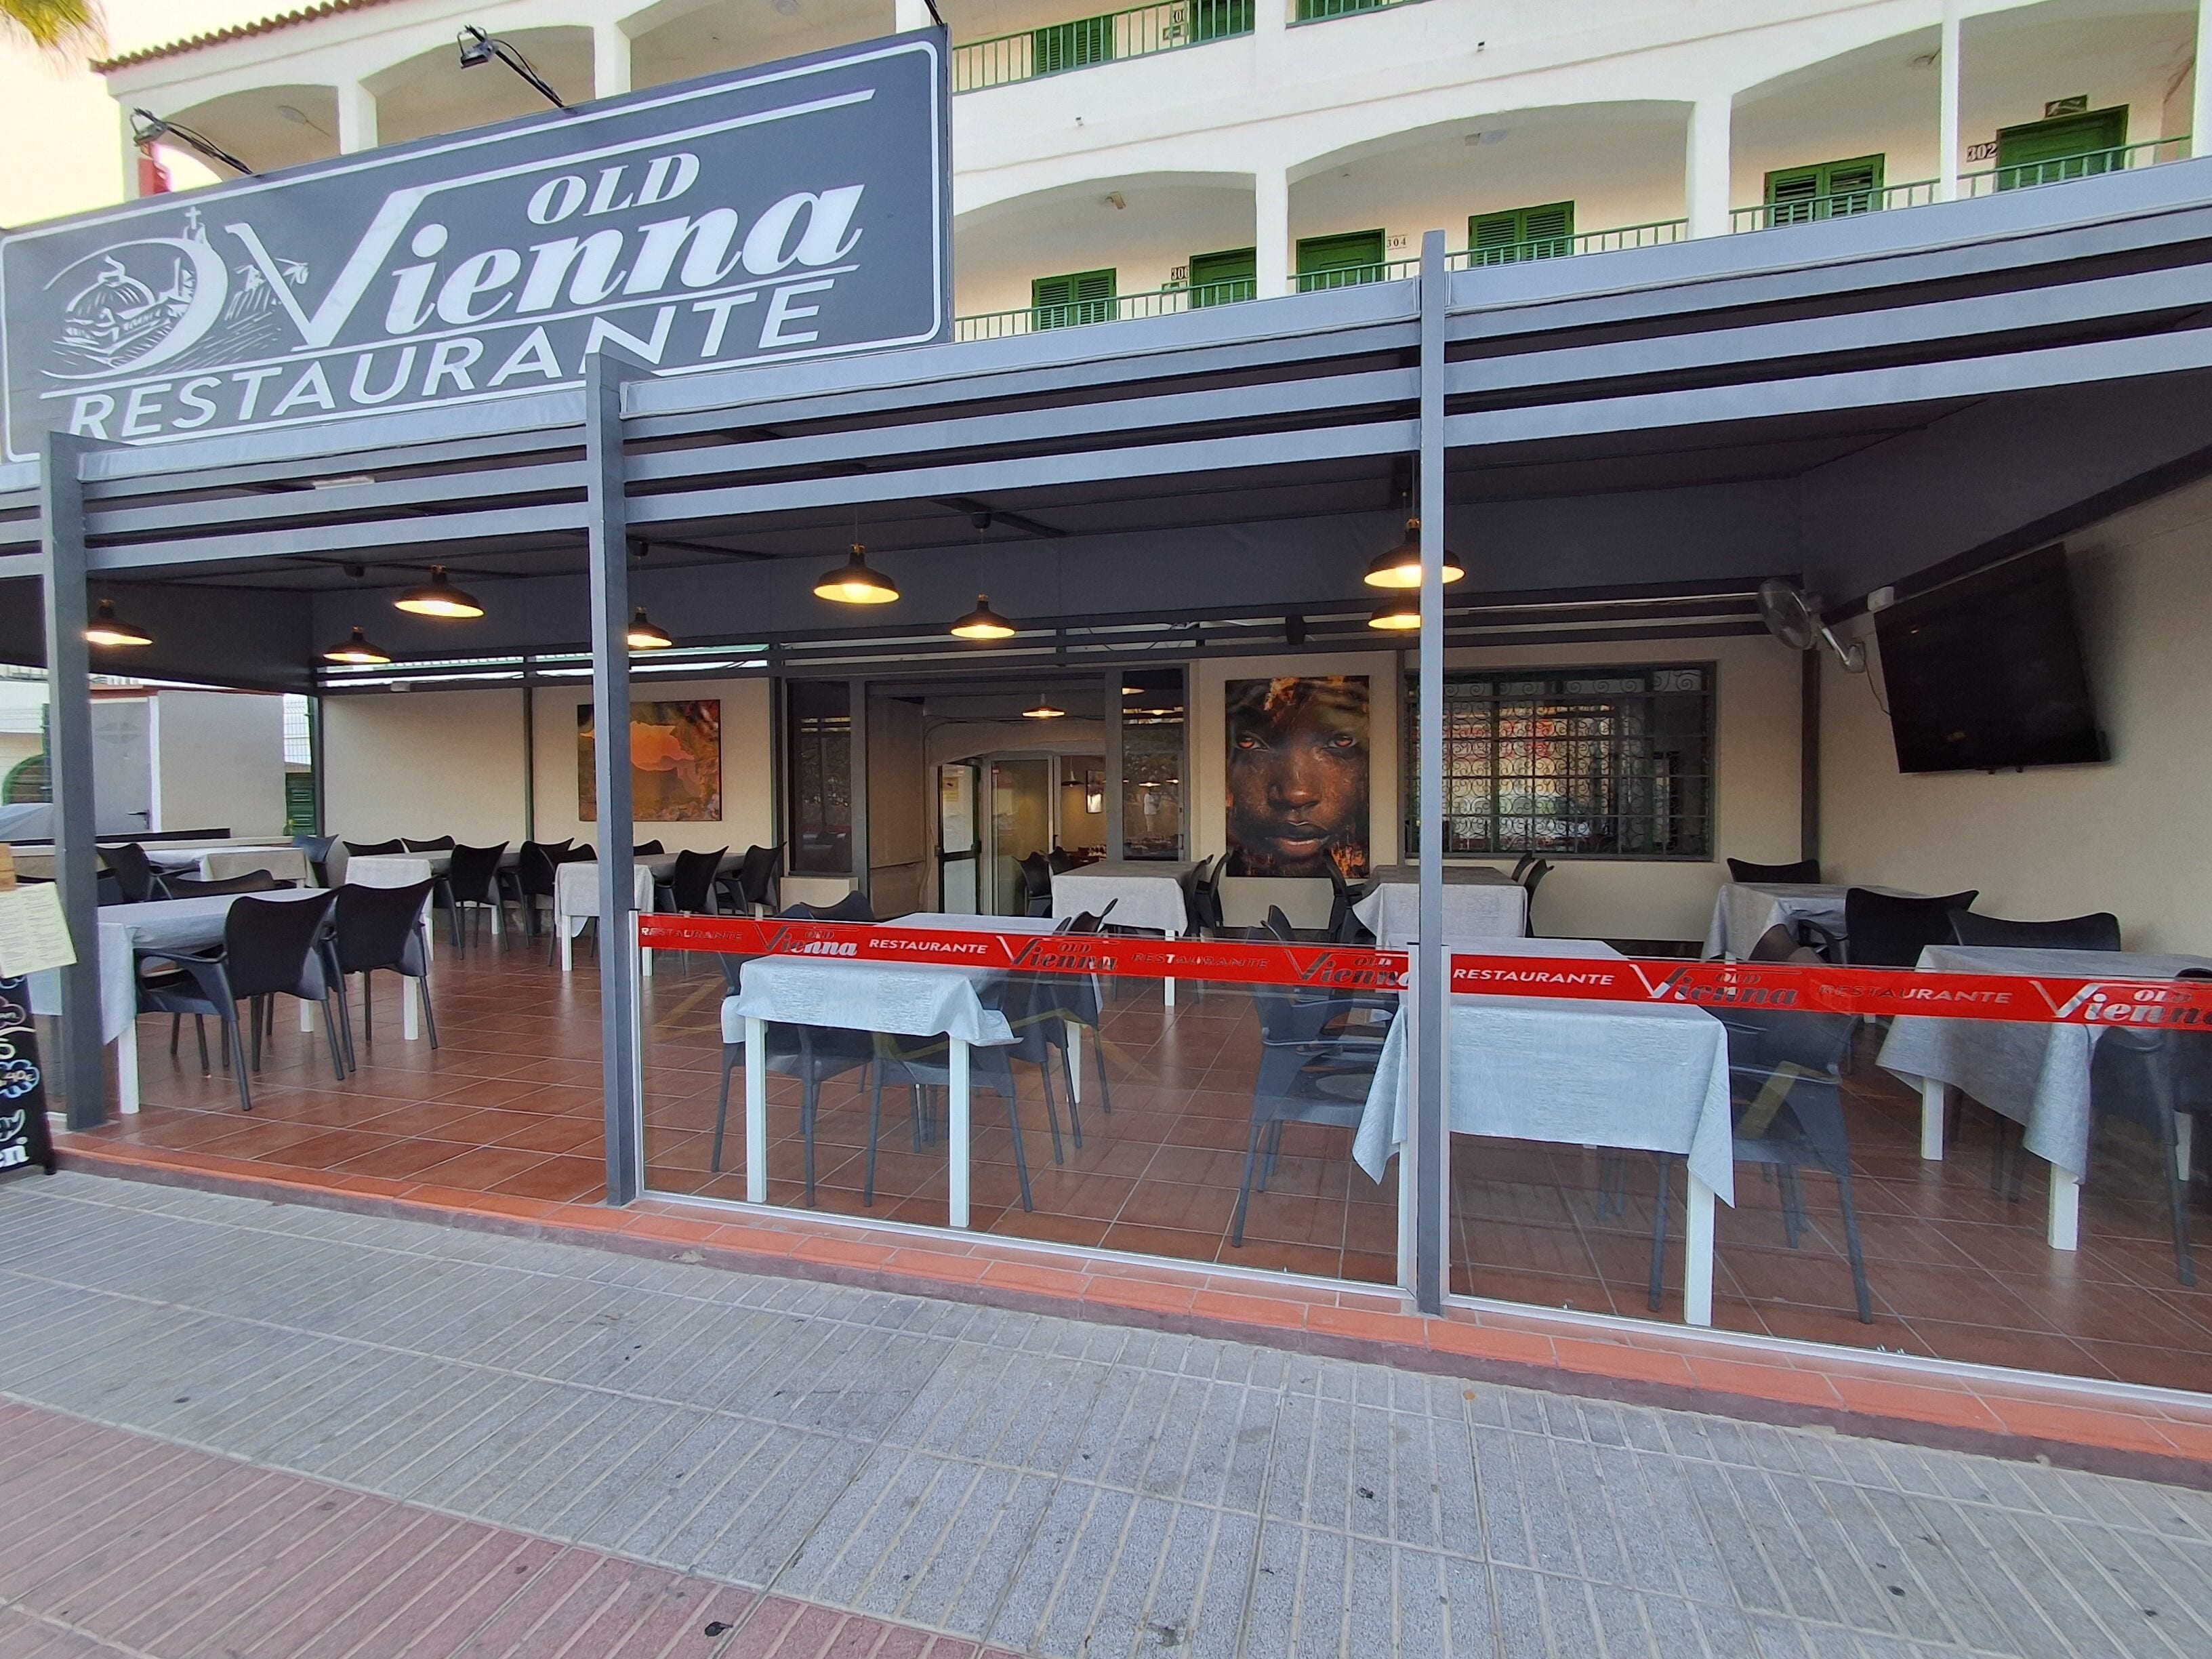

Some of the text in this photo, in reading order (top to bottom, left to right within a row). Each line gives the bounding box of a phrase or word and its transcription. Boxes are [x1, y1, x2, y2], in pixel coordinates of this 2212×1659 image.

[1967, 142, 1998, 161] 302
[527, 152, 700, 224] OLD
[1387, 237, 1406, 248] 304
[224, 182, 865, 351] Vienna
[69, 278, 836, 441] RESTAURANTE
[753, 922, 857, 956] Vienna
[869, 939, 989, 955] RESTAURANTE
[996, 935, 1118, 971] Vienna
[1132, 953, 1270, 969] RESTAURANTE
[1453, 968, 1616, 986] RESTAURANTE
[1629, 964, 1798, 1005] Vienna
[1818, 984, 2013, 1004] RESTAURANTE
